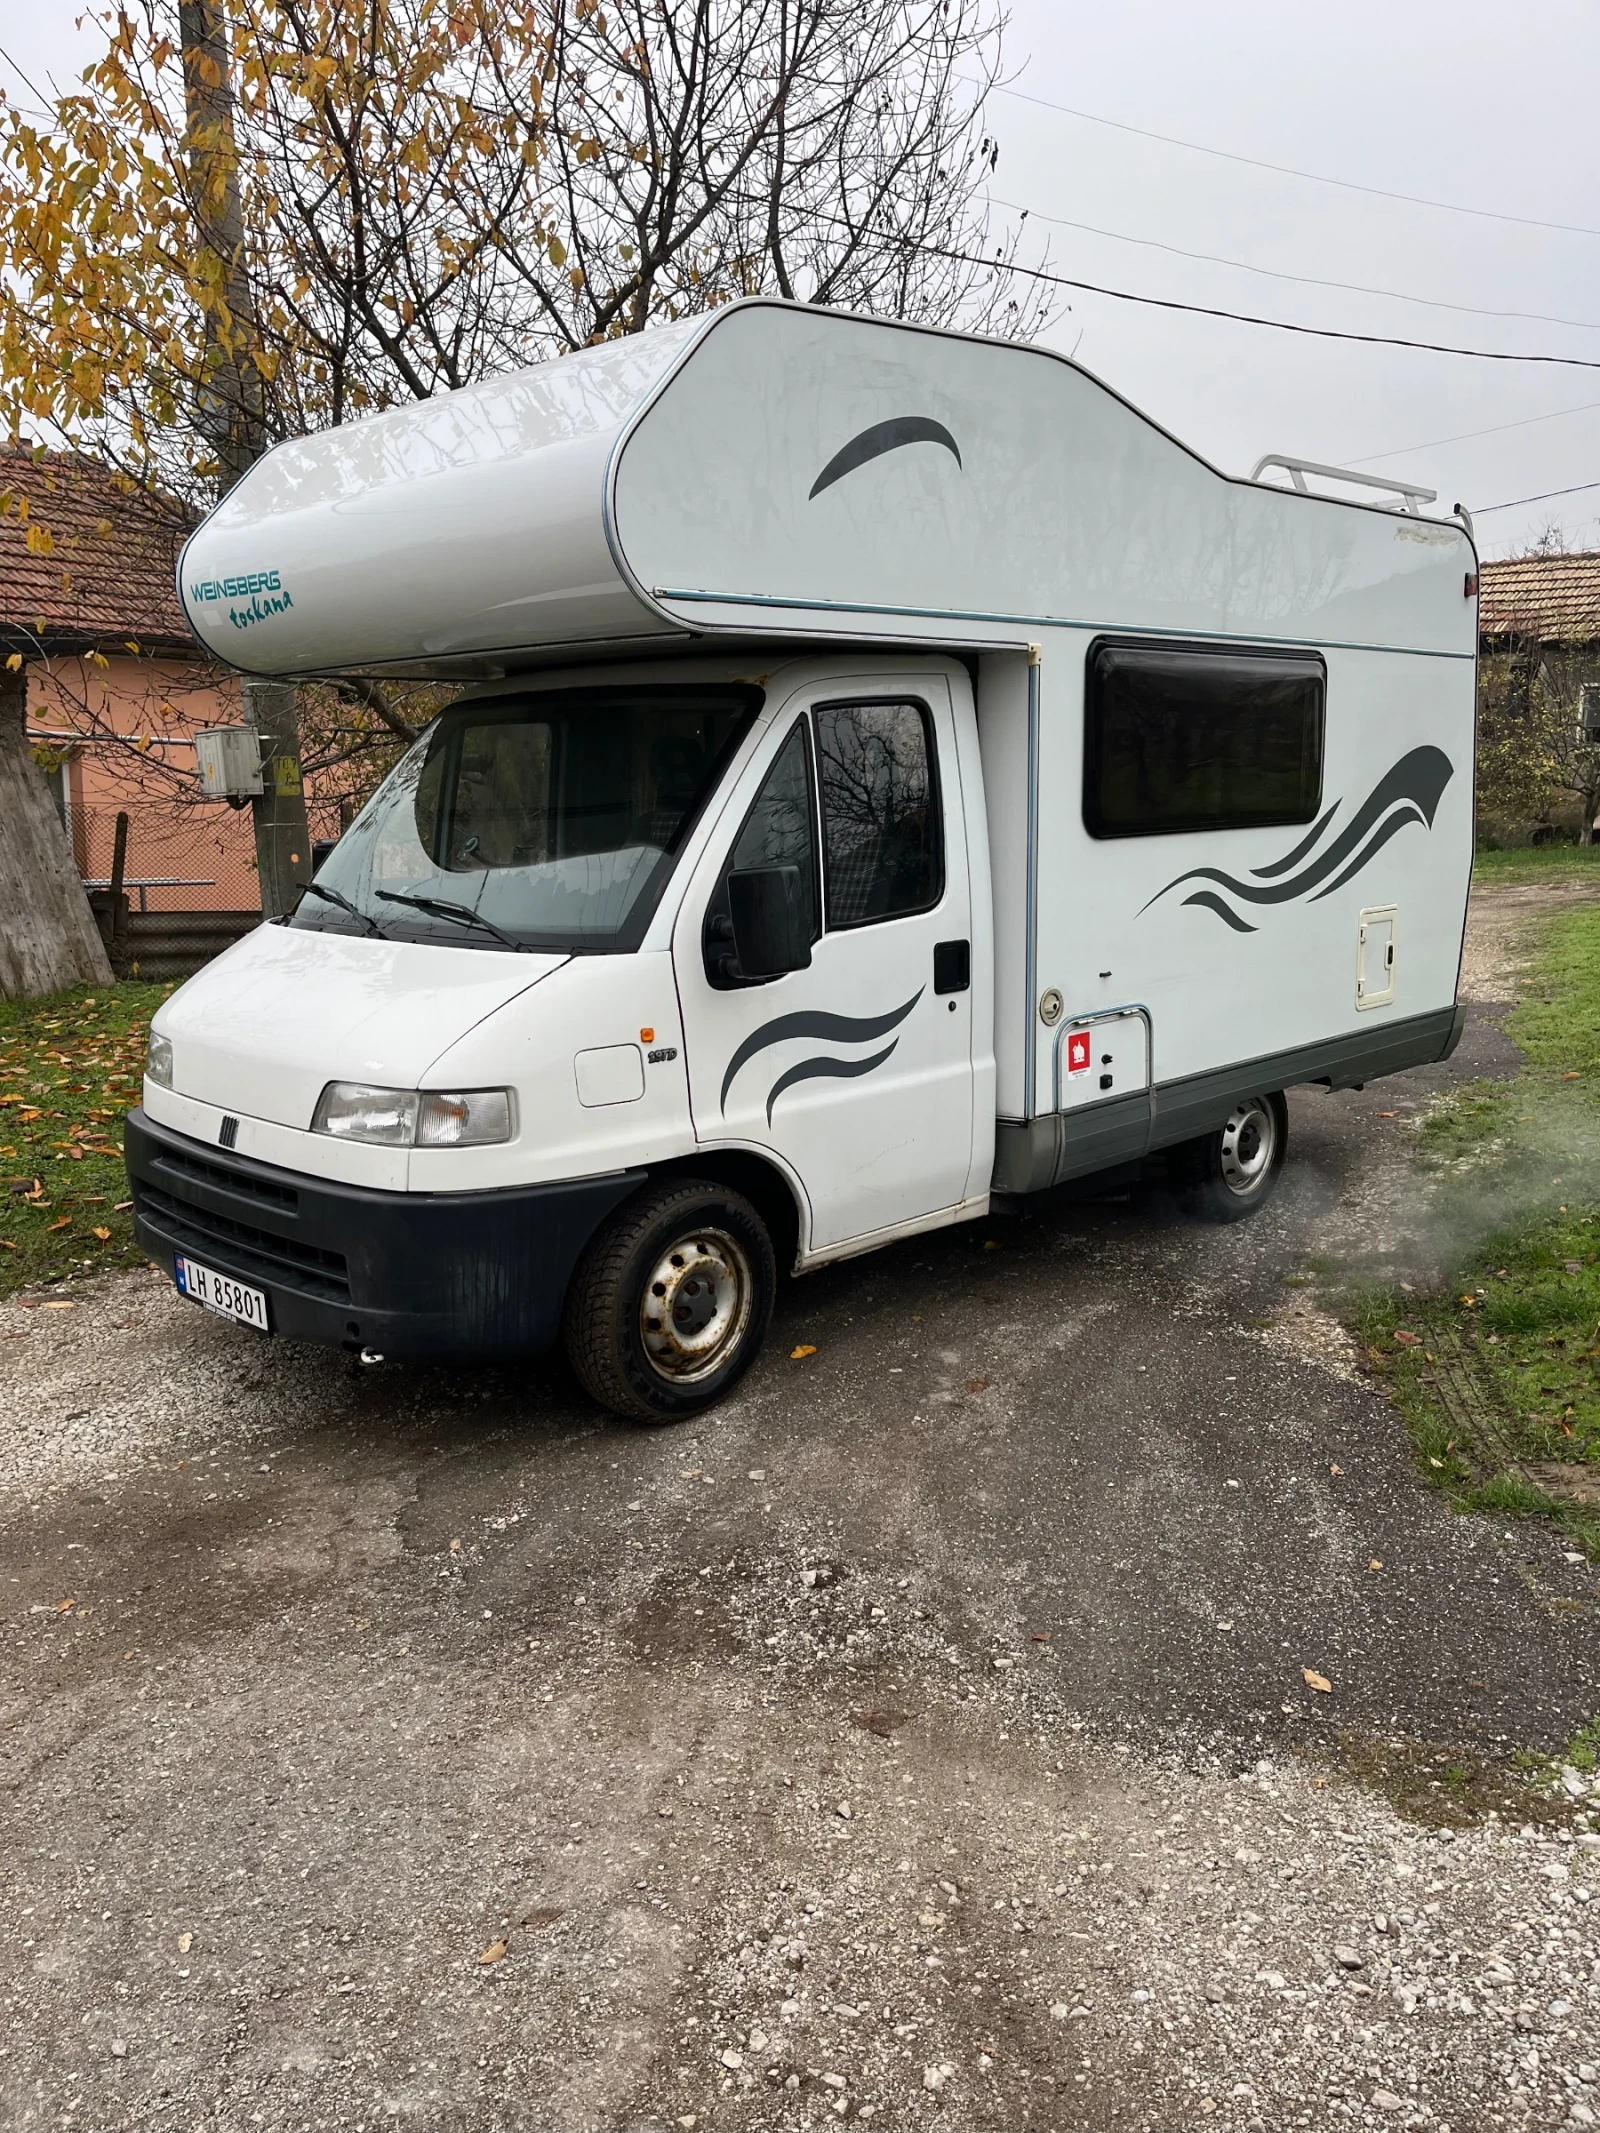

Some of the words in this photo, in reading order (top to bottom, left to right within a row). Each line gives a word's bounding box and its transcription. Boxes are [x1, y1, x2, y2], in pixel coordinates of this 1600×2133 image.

[190, 570, 281, 602] WEINSBERG
[229, 591, 294, 629] toskana
[187, 1264, 208, 1299] LH
[213, 1277, 263, 1324] 85801
